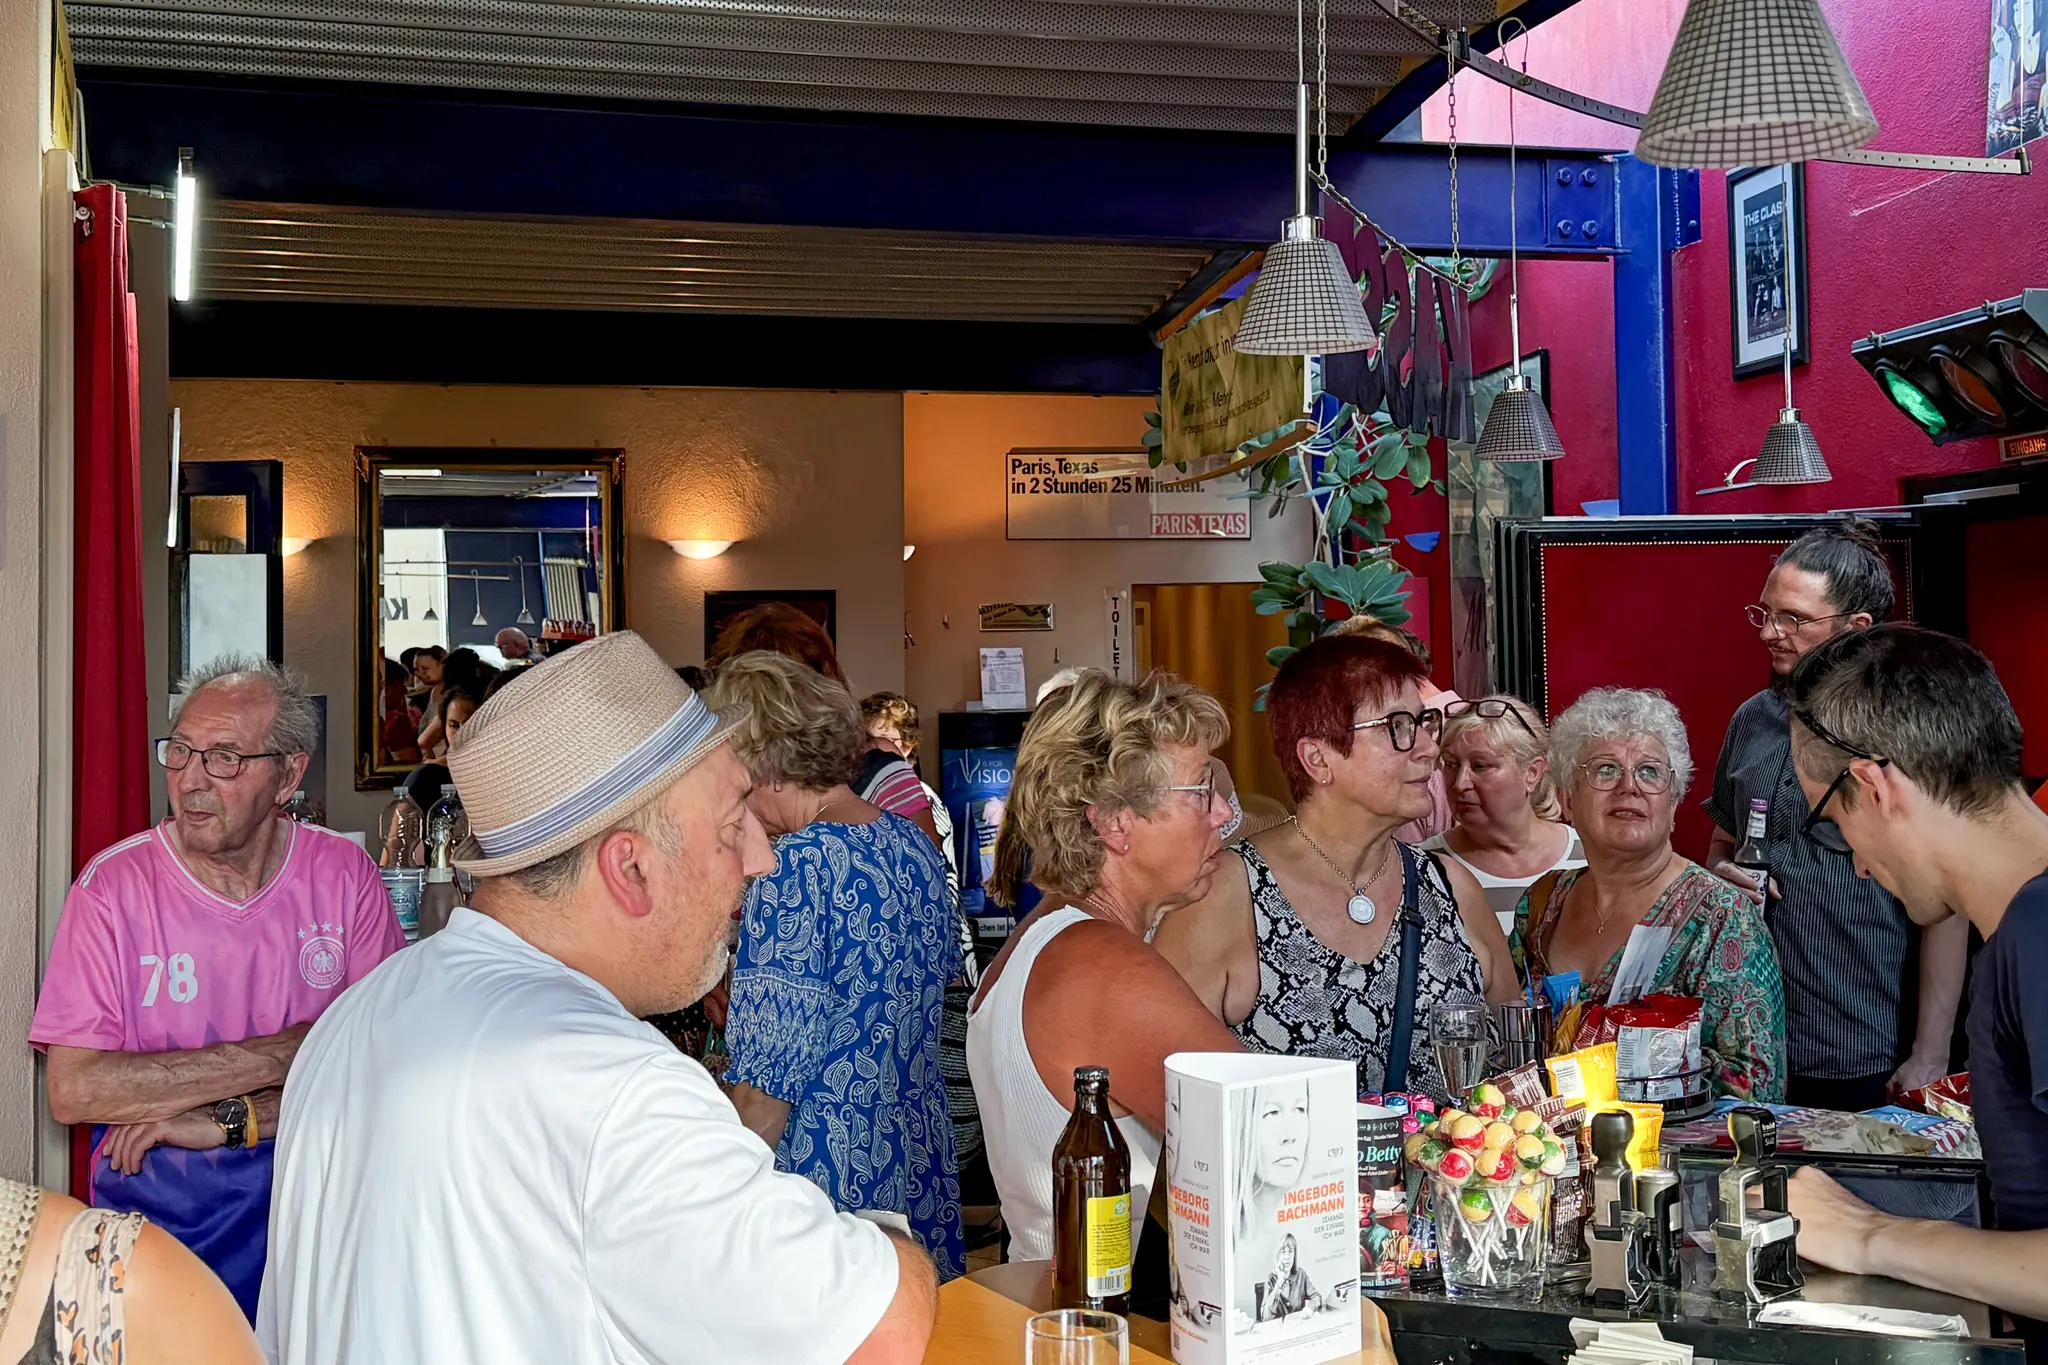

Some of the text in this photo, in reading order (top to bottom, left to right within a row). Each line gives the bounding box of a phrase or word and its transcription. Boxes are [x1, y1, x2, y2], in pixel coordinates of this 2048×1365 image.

[1744, 200, 1785, 227] THE CLAS
[2010, 437, 2047, 456] EINGANG
[1011, 457, 1099, 477] Paris,Texas
[1011, 477, 1026, 494] in
[1029, 477, 1040, 494] 2
[1043, 476, 1108, 494] Stunden
[1111, 476, 1132, 494] 25
[1152, 514, 1246, 536] PARIS,TEXAS
[958, 748, 1015, 785] VISIO
[140, 952, 199, 1007] 78
[1365, 1145, 1402, 1165] Betty
[1284, 1180, 1345, 1206] INGEBORG
[1277, 1196, 1345, 1224] BACHMANN
[1314, 1225, 1325, 1234] DER
[1322, 1229, 1345, 1240] ICH WAR
[1385, 1277, 1402, 1286] Kino
